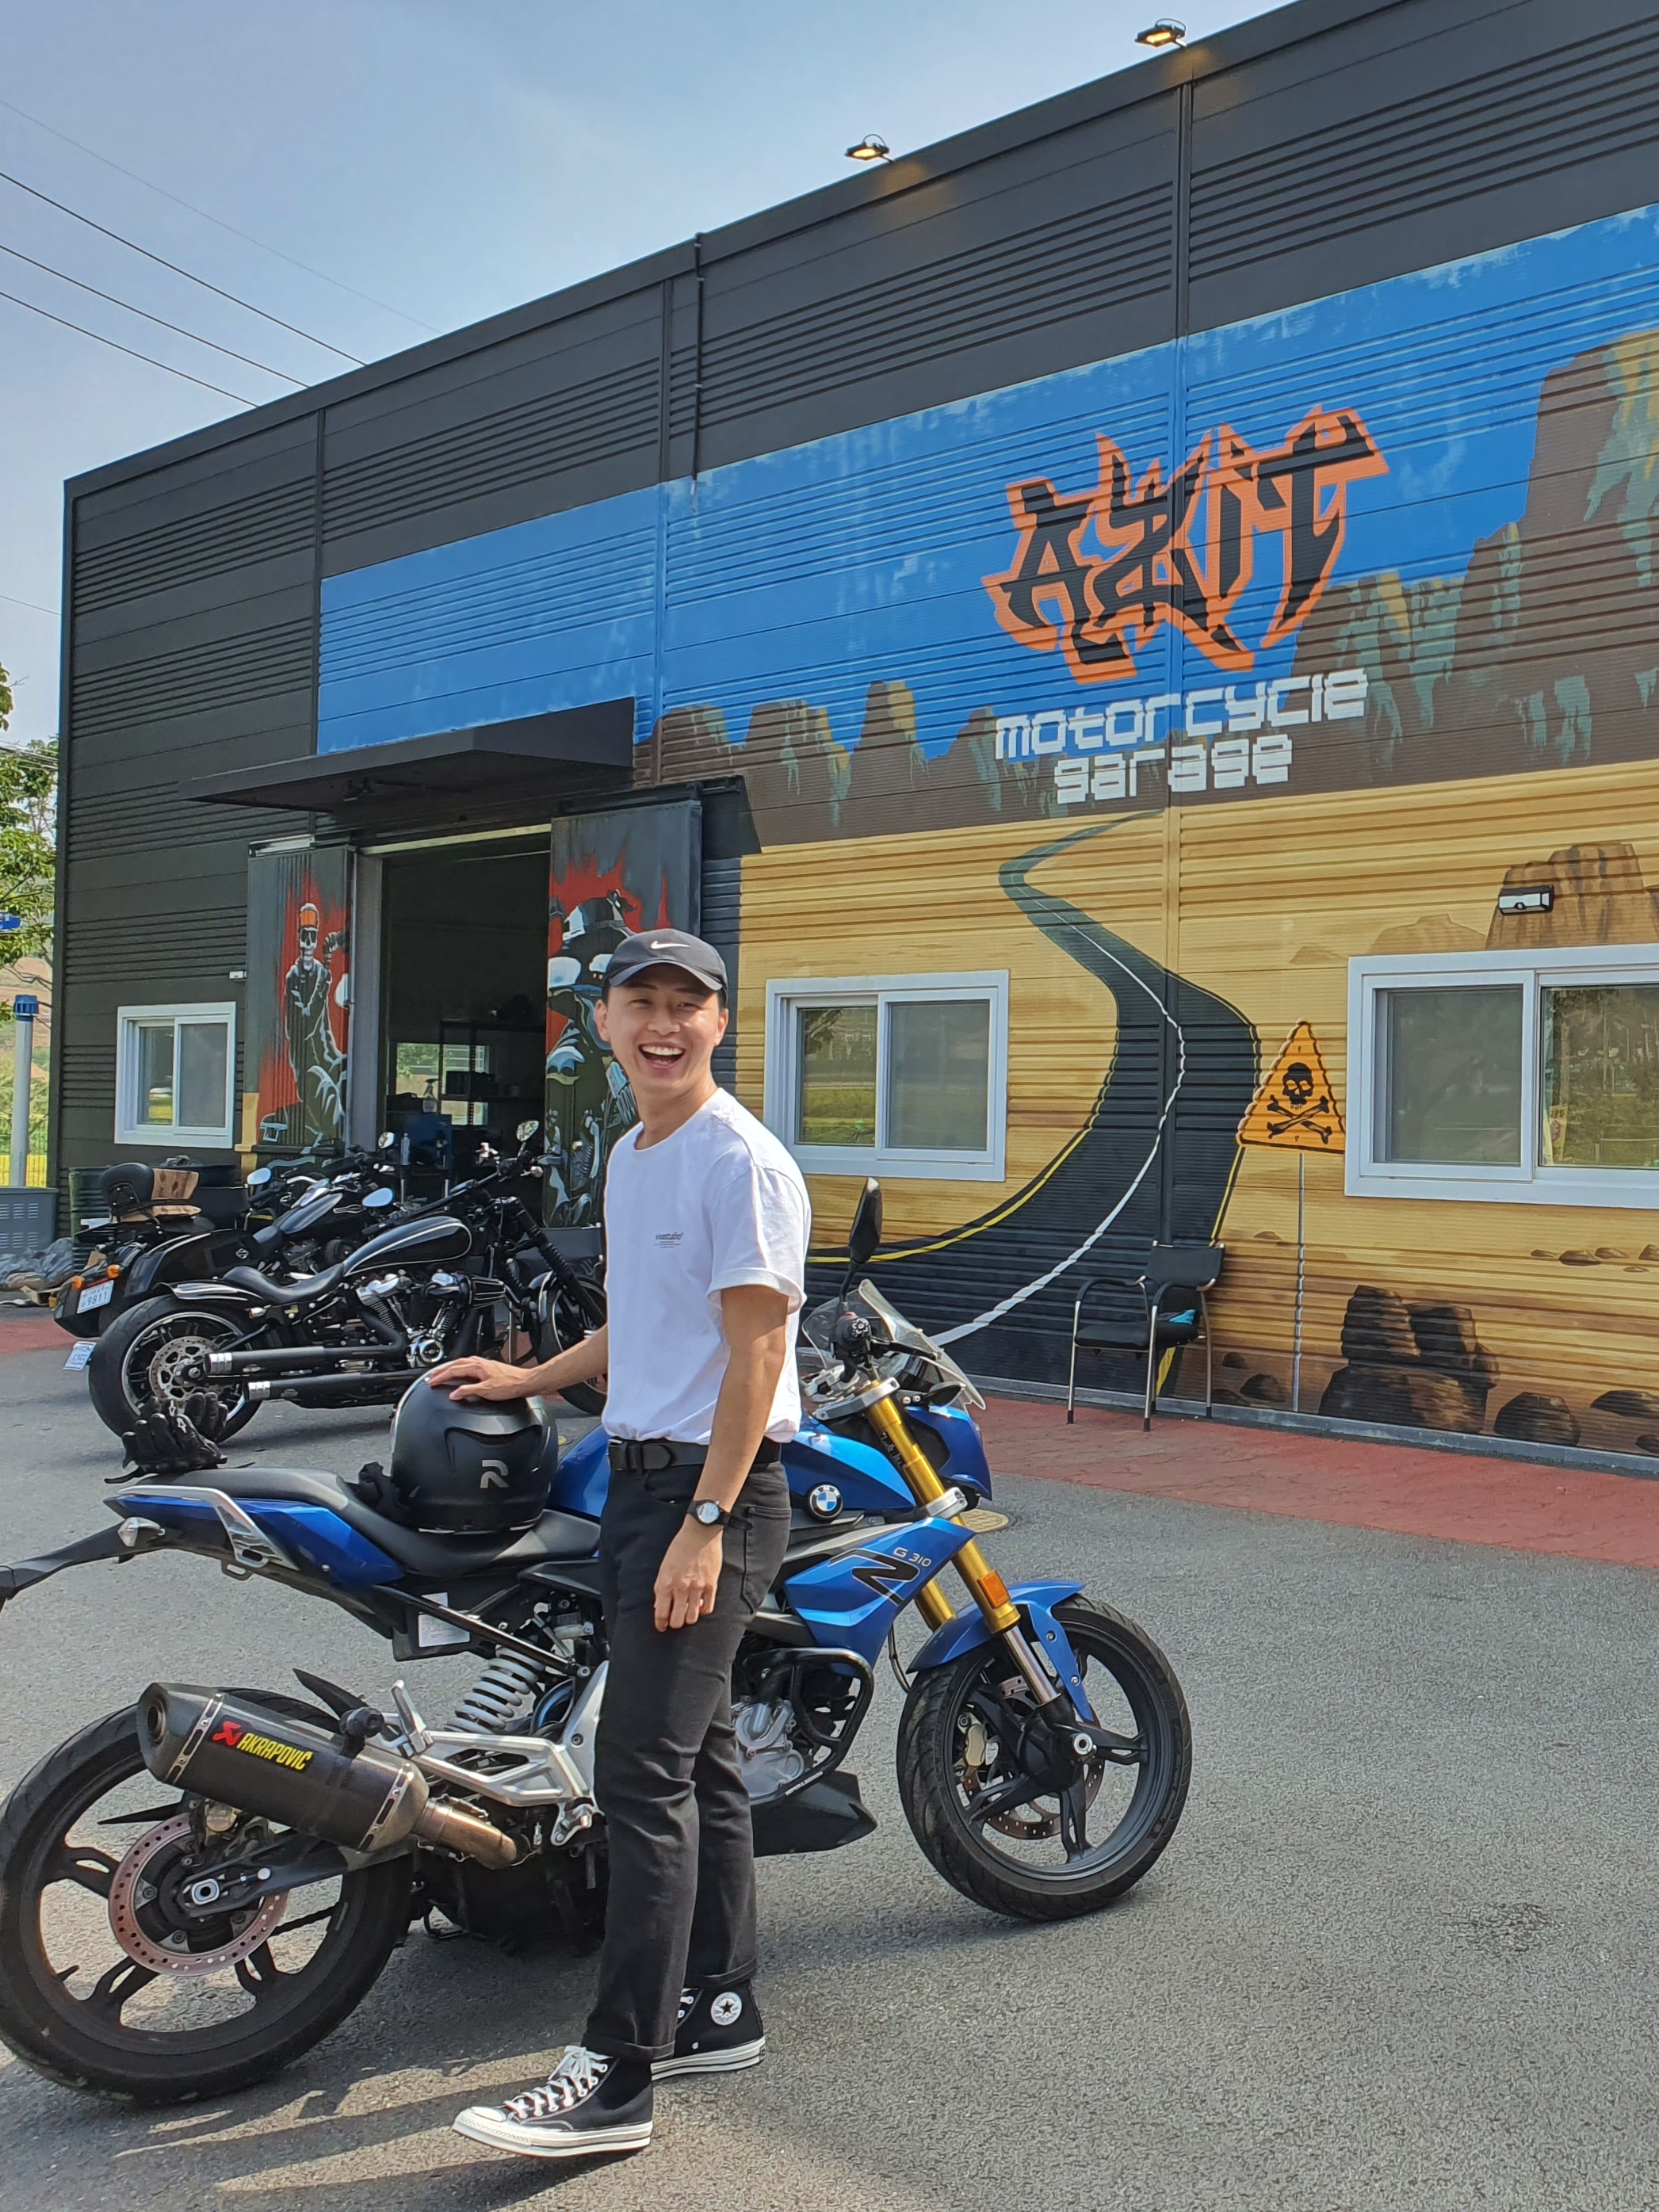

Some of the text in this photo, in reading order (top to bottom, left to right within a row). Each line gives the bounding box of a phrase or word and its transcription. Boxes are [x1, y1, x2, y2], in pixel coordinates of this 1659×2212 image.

[995, 668, 1368, 760] motorcycle
[1054, 734, 1293, 804] garage
[893, 1546, 932, 1568] G 310
